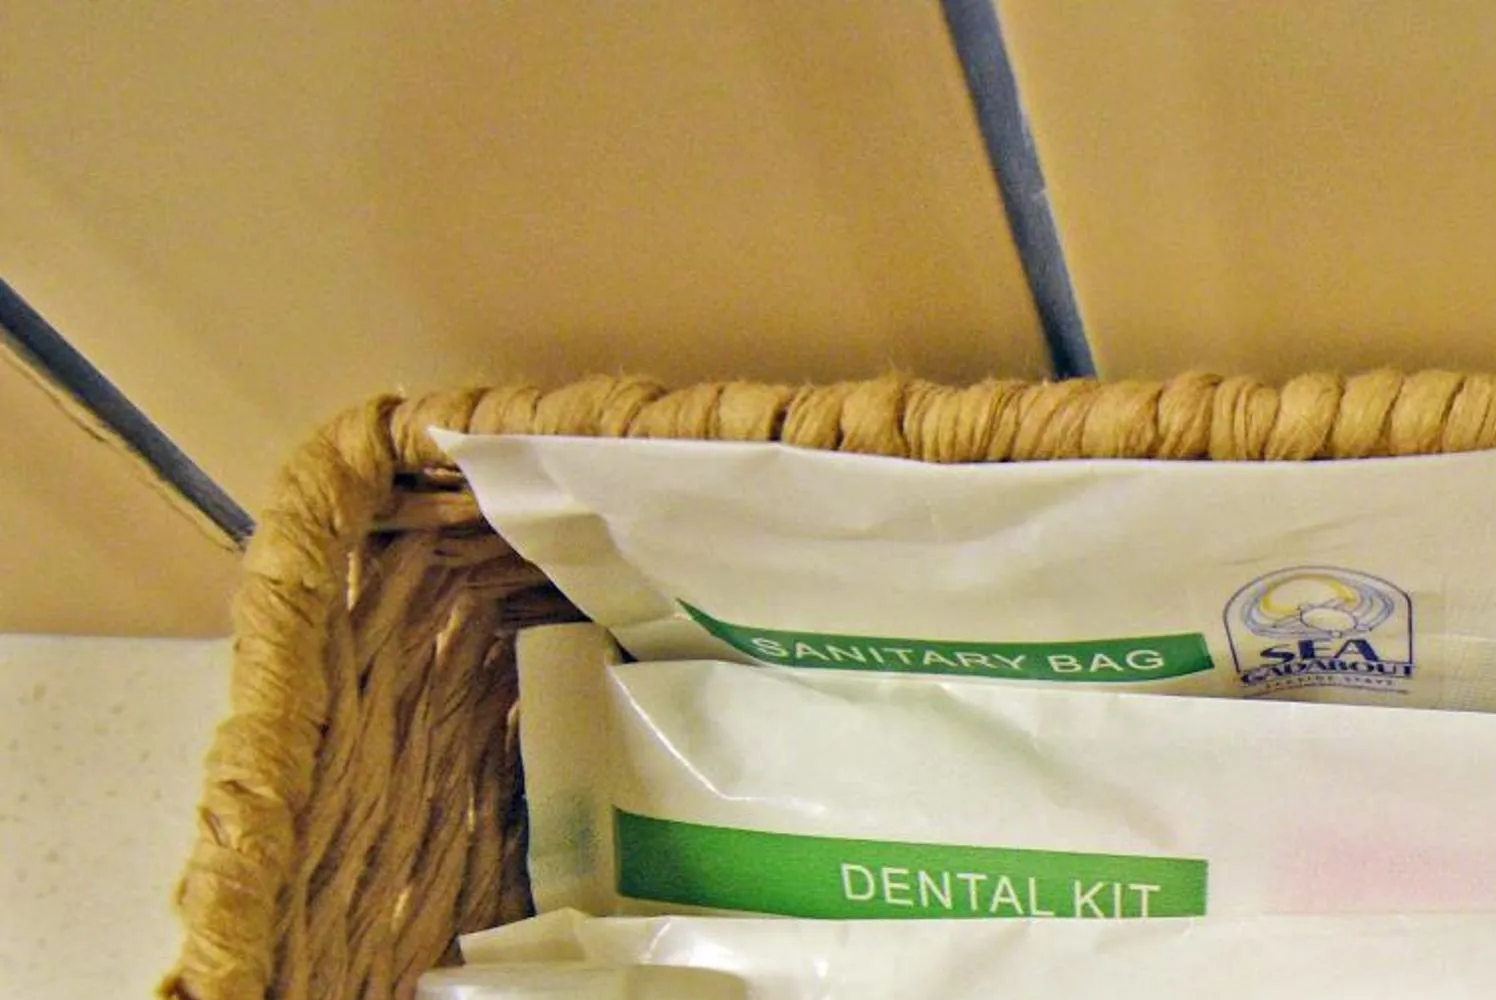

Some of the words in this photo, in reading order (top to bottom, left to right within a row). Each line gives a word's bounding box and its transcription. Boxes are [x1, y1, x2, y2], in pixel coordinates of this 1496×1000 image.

[751, 637, 1026, 671] SANITARY
[1048, 649, 1165, 673] BAG
[1260, 639, 1379, 668] SEA
[840, 862, 1055, 917] DENTAL
[1073, 879, 1162, 918] KIT
